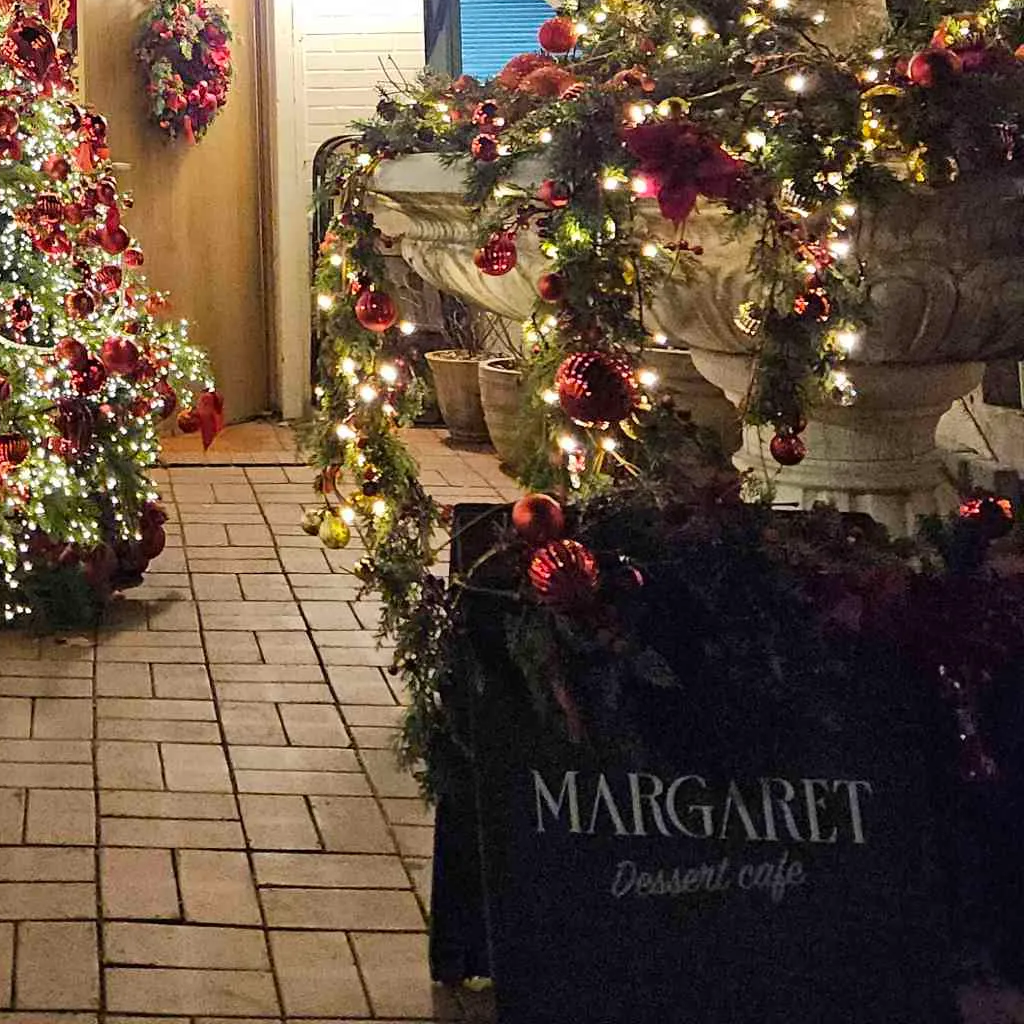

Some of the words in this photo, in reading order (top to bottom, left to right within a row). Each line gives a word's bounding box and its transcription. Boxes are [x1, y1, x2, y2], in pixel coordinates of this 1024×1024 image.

[528, 769, 873, 844] MARGARET
[611, 856, 731, 899] Dessert
[738, 849, 807, 904] cafe
